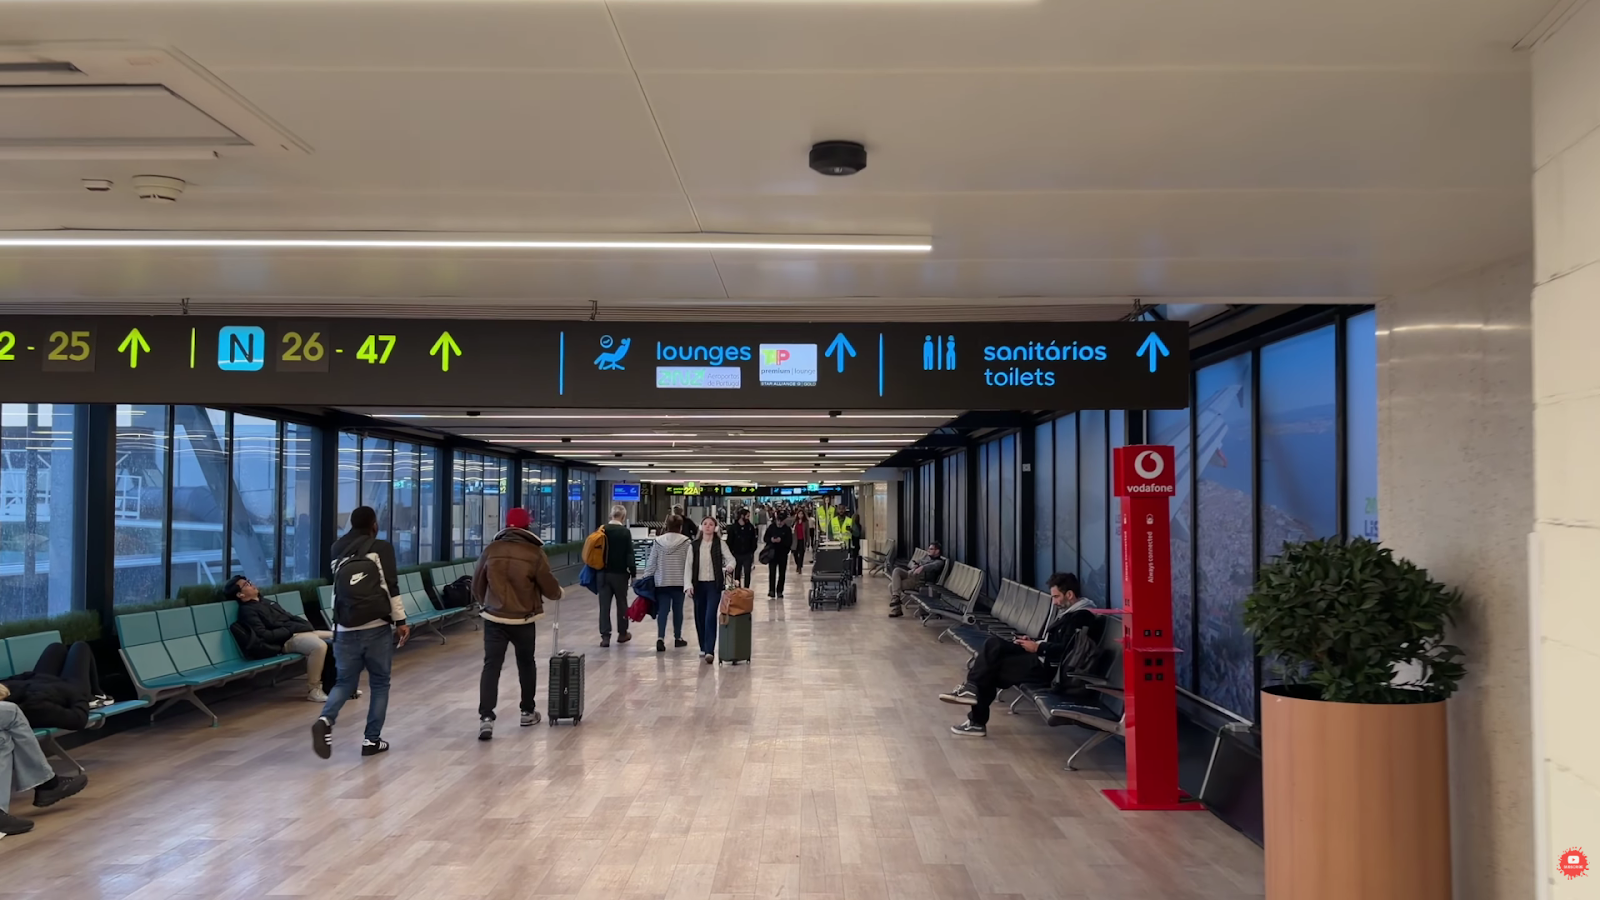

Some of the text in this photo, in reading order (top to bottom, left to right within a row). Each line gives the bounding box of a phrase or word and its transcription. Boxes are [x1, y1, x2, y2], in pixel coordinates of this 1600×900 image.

[0, 331, 16, 360] 2
[48, 331, 90, 361] 25
[230, 333, 253, 363] N
[282, 332, 324, 361] 26
[356, 335, 396, 364] 47
[657, 341, 751, 366] lounges
[984, 340, 1107, 361] sanitários
[984, 367, 1056, 386] toilets
[1127, 483, 1173, 493] vodafone
[1147, 562, 1155, 583] Always
